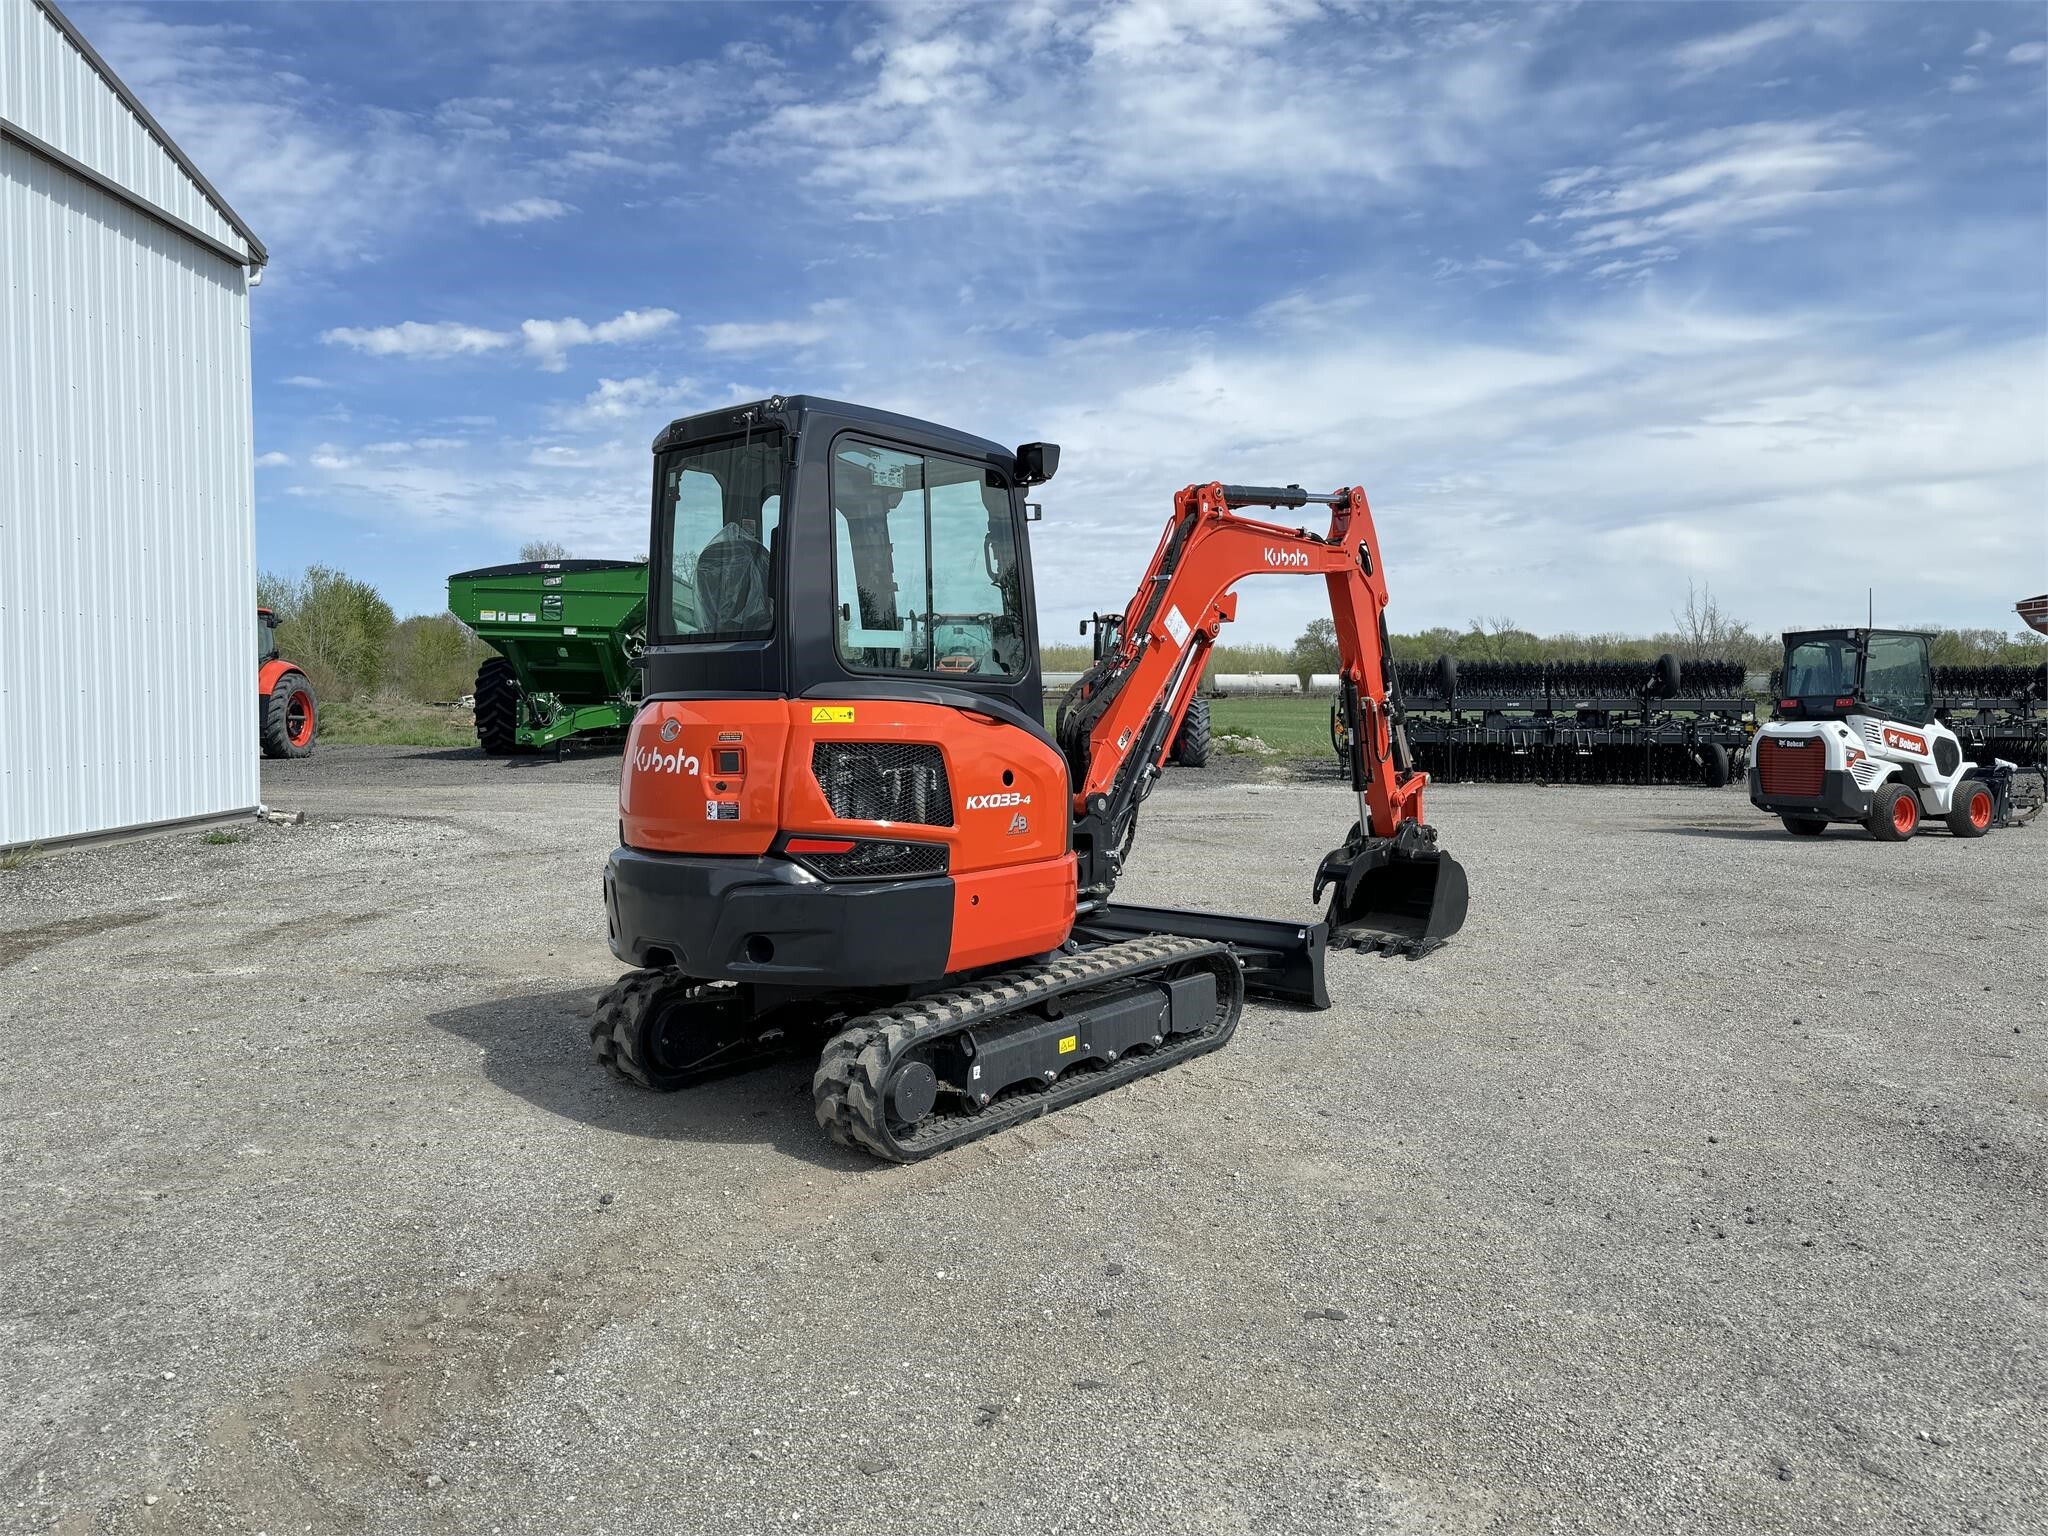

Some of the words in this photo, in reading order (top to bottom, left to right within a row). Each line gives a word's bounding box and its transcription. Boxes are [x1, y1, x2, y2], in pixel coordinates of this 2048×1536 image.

[1264, 547, 1309, 567] Kubota
[1898, 737, 1923, 752] Bobcat
[633, 746, 699, 776] Kubota
[965, 792, 1031, 810] KX033-4
